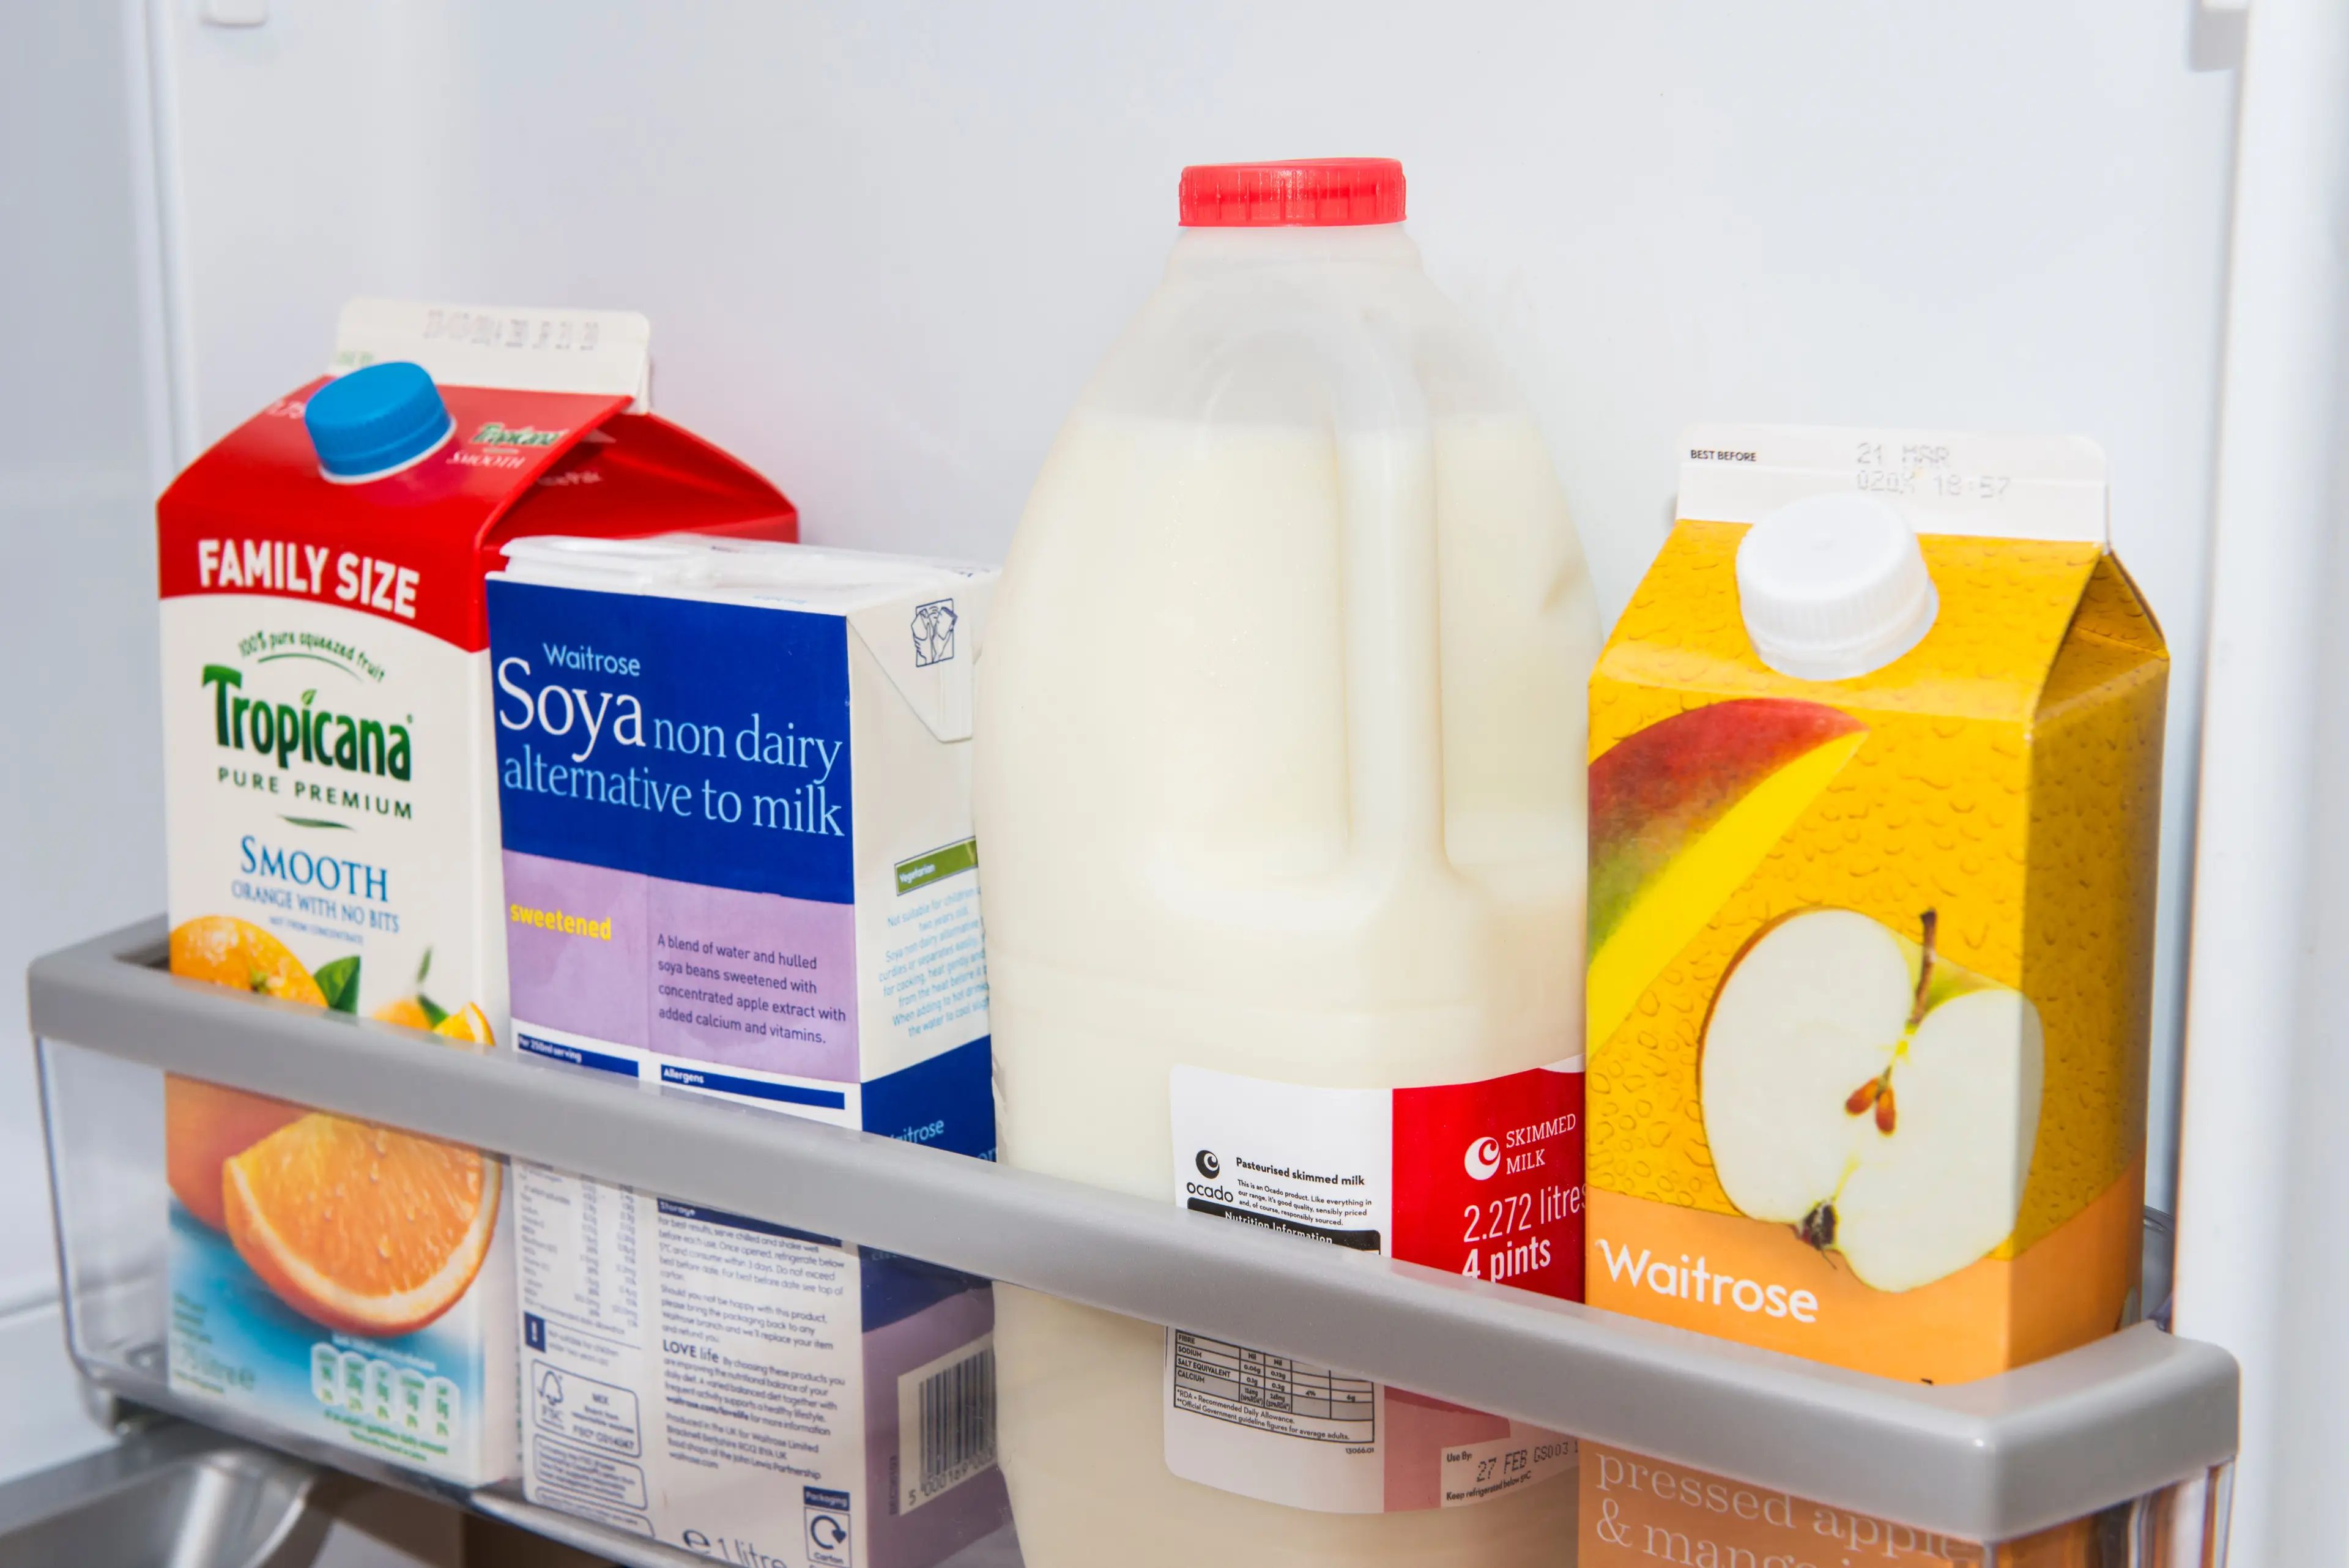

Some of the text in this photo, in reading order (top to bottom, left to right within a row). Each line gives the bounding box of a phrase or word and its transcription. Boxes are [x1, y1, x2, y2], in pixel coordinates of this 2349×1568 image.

[1691, 449, 1757, 462] BEST BEFORE
[198, 539, 420, 619] FAMILY SIZE
[270, 630, 295, 649] pure
[300, 631, 355, 661] squeezed
[357, 652, 385, 683] fruit
[542, 642, 640, 677] Waitrose
[202, 663, 413, 782] Tropicana
[497, 656, 843, 784] Soya non dairy
[218, 767, 412, 820] PURE PREMIUM
[503, 744, 845, 836] alternative to milk
[240, 835, 389, 902] SMOOTH
[232, 881, 399, 934] ORANGE WITH NO BITS
[510, 903, 612, 941] sweetened
[658, 934, 817, 970] A blend of water and hulled
[658, 959, 817, 994] soya beans sweetened with
[658, 984, 846, 1022] concentrated apple extract with
[659, 1008, 826, 1044] added calcium and vitamins.
[554, 1047, 582, 1064] serving
[663, 1068, 704, 1084] Allergens
[890, 1120, 944, 1143] itrose
[1506, 1113, 1576, 1148] SKIMMED
[1236, 1157, 1365, 1185] Pasteurised skimmed milk
[1506, 1149, 1545, 1175] MILK
[660, 1202, 696, 1217] Storage
[1187, 1182, 1233, 1203] ocado
[1249, 1193, 1266, 1202] range,
[1293, 1203, 1314, 1213] quality,
[1316, 1208, 1343, 1217] sensibly
[1264, 1186, 1283, 1195] Ocado
[1285, 1192, 1309, 1202] product.
[1260, 1205, 1280, 1214] course,
[1281, 1210, 1313, 1222] responsibly
[1463, 1193, 1531, 1243] 2.272
[1462, 1236, 1551, 1284] 4 pints
[1595, 1239, 1819, 1323] Waitrose
[1178, 1334, 1195, 1344] FIBRE
[664, 1339, 697, 1358] LOVE
[700, 1345, 719, 1363] life
[791, 1369, 827, 1386] products
[829, 1375, 845, 1386] you
[1178, 1346, 1201, 1358] SODIUM
[1244, 1364, 1261, 1373] 0.06g
[1178, 1358, 1192, 1367] SALT
[1193, 1363, 1231, 1378] EQUIVALENT
[1272, 1383, 1285, 1392] 0.2g
[1178, 1370, 1204, 1383] CALCIUM
[1198, 1395, 1242, 1413] Recommended
[1244, 1407, 1259, 1417] Daily
[1261, 1411, 1294, 1424] Allowance.
[1202, 1405, 1237, 1421] Government
[1238, 1413, 1265, 1427] guideline
[1267, 1419, 1287, 1430] figures
[1447, 1453, 1461, 1462] Use
[1477, 1458, 1497, 1482] 27
[1504, 1449, 1527, 1474] FEB
[805, 1491, 848, 1507] Packaging
[1446, 1492, 1464, 1501] Keep
[1466, 1481, 1502, 1498] refrigerated
[1504, 1476, 1520, 1488] below
[1596, 1452, 1796, 1529] pressed
[1596, 1497, 1819, 1568] & man
[813, 1551, 844, 1564] Carton
